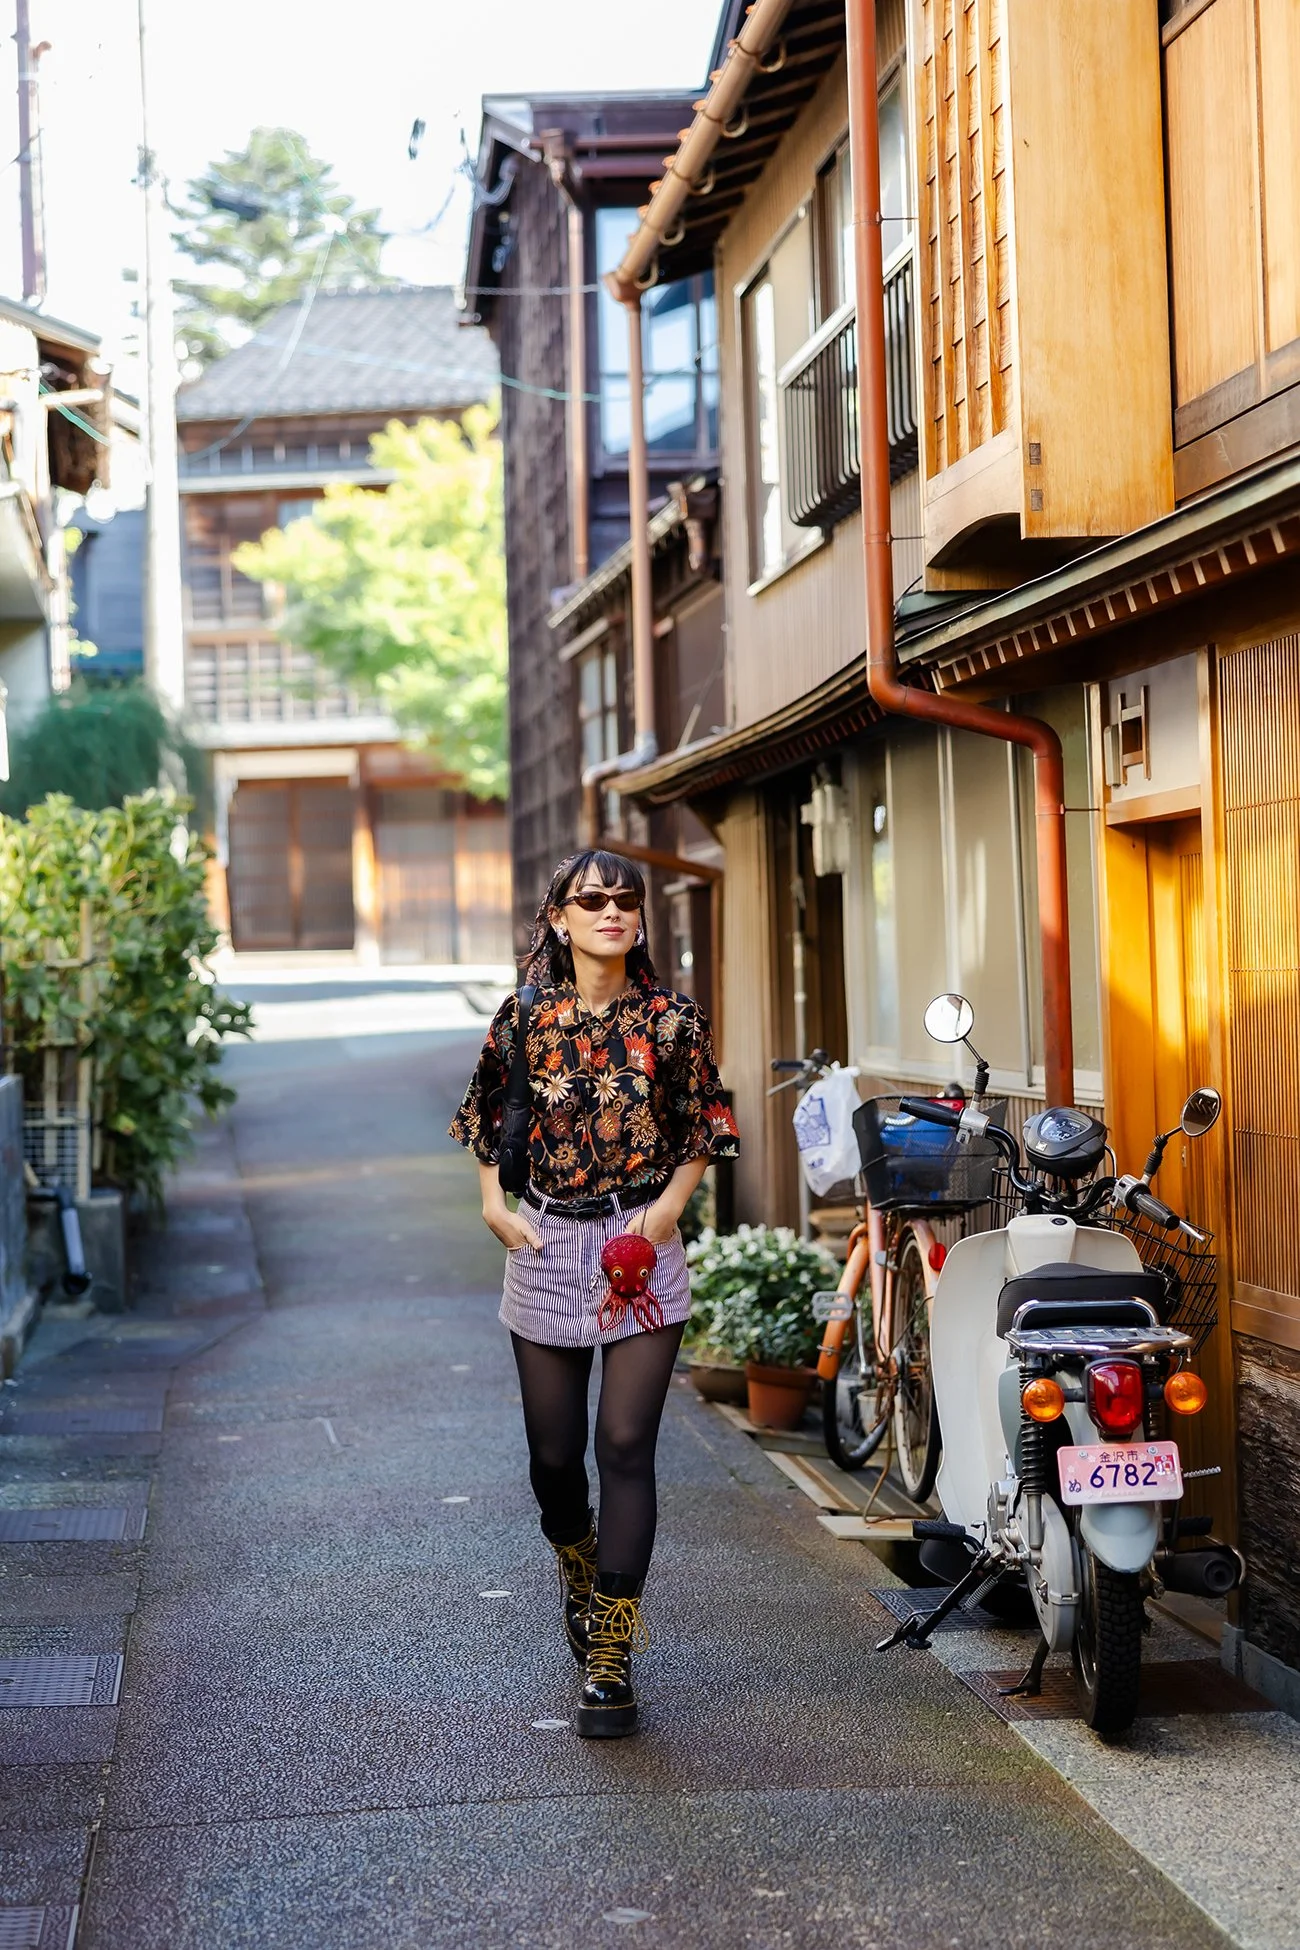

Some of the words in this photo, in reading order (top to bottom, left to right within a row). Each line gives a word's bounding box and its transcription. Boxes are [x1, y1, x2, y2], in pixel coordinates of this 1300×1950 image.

[1099, 1450, 1138, 1462] 金沢市
[1068, 1478, 1082, 1493] ぬ
[1090, 1463, 1157, 1488] 6782
